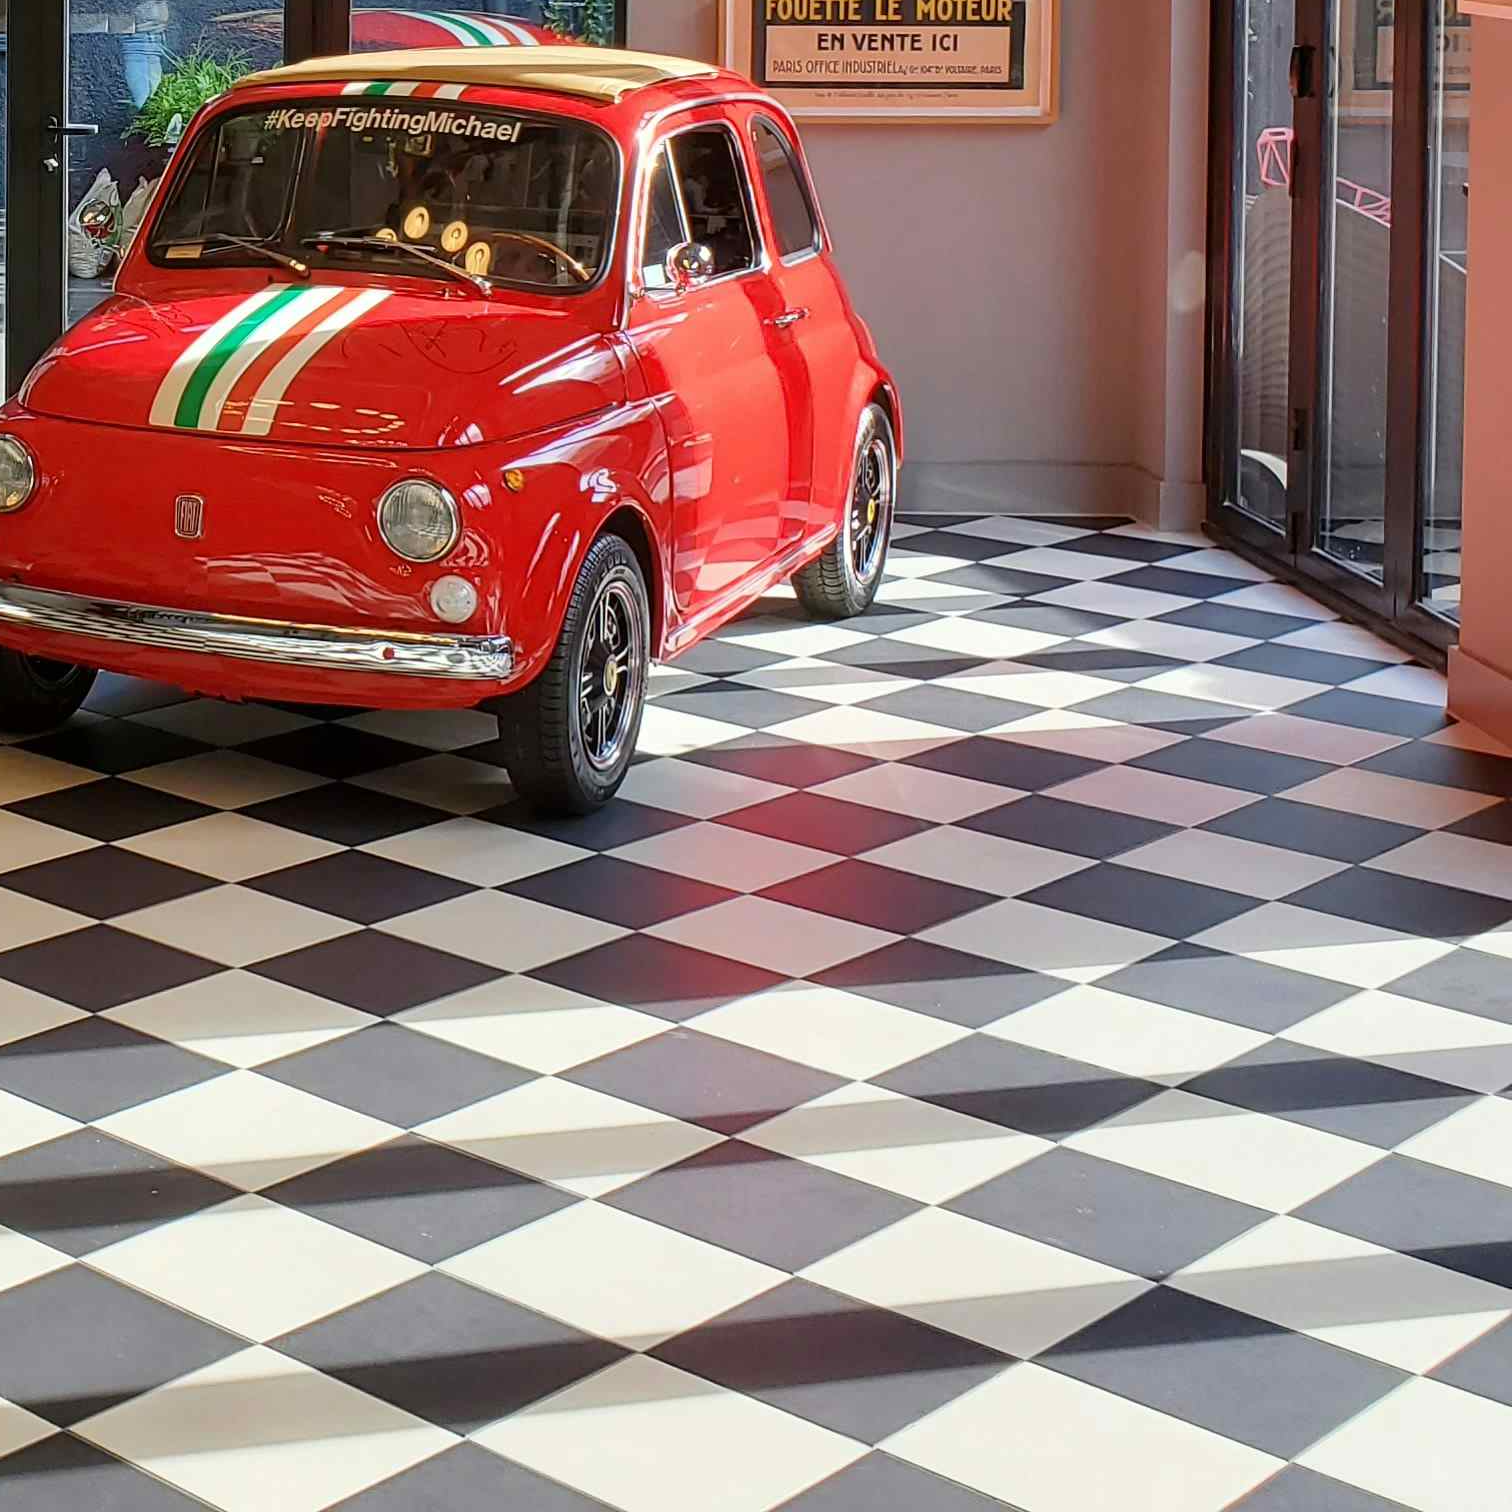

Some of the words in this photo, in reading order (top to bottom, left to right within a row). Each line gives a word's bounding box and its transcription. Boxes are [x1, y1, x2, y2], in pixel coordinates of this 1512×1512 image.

[817, 33, 845, 51] EN
[851, 33, 923, 51] VENTE
[932, 33, 958, 51] ICI
[772, 60, 802, 74] PARIS
[805, 60, 840, 74] OFFICE
[263, 107, 522, 143] #KeepFightingMichael
